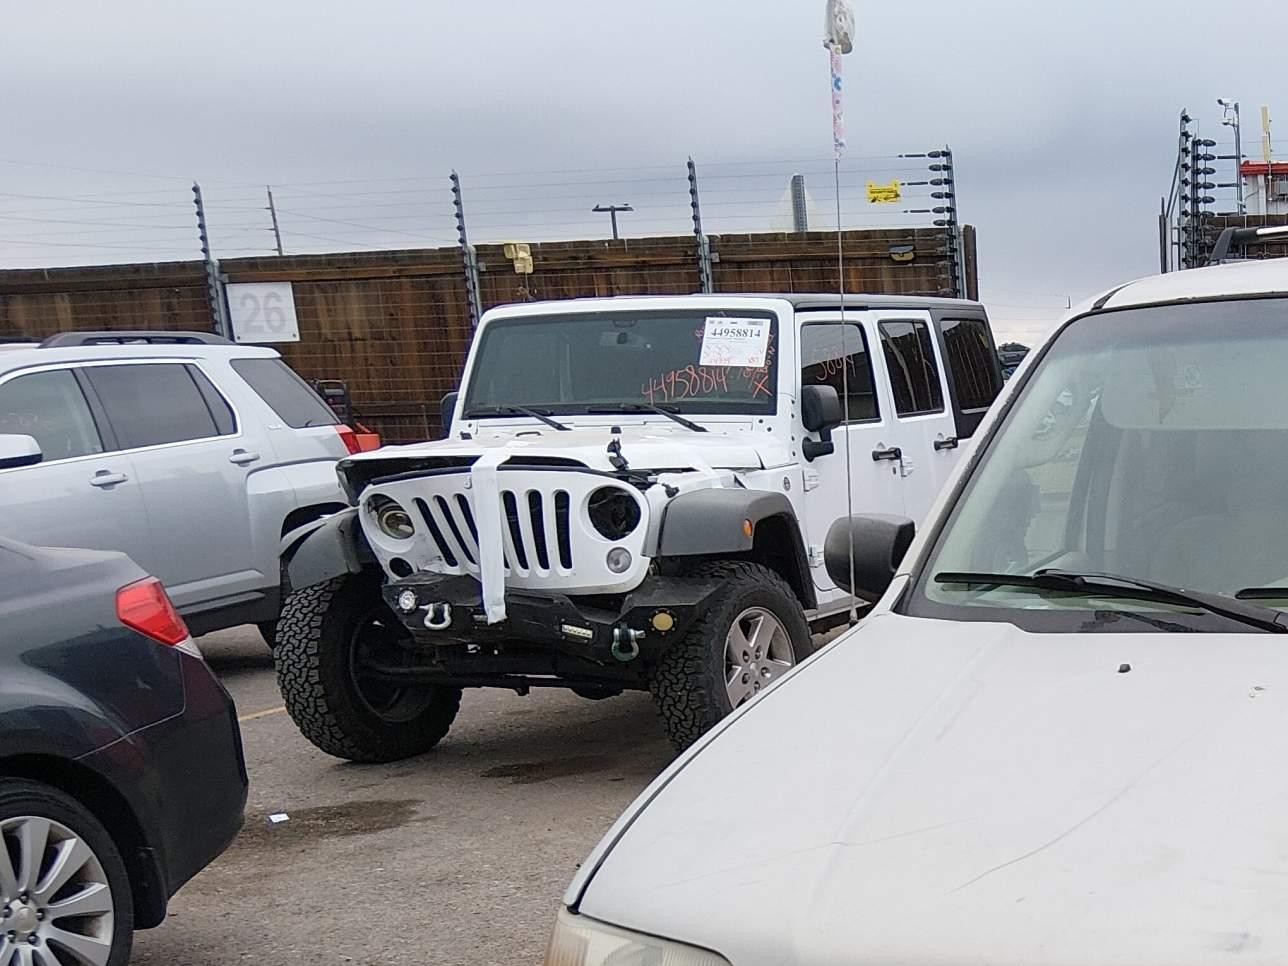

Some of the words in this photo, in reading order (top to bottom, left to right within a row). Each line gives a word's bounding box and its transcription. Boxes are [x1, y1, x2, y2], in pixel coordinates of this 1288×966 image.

[241, 292, 287, 333] 26
[711, 328, 761, 338] 44958814
[641, 365, 729, 408] 44958814
